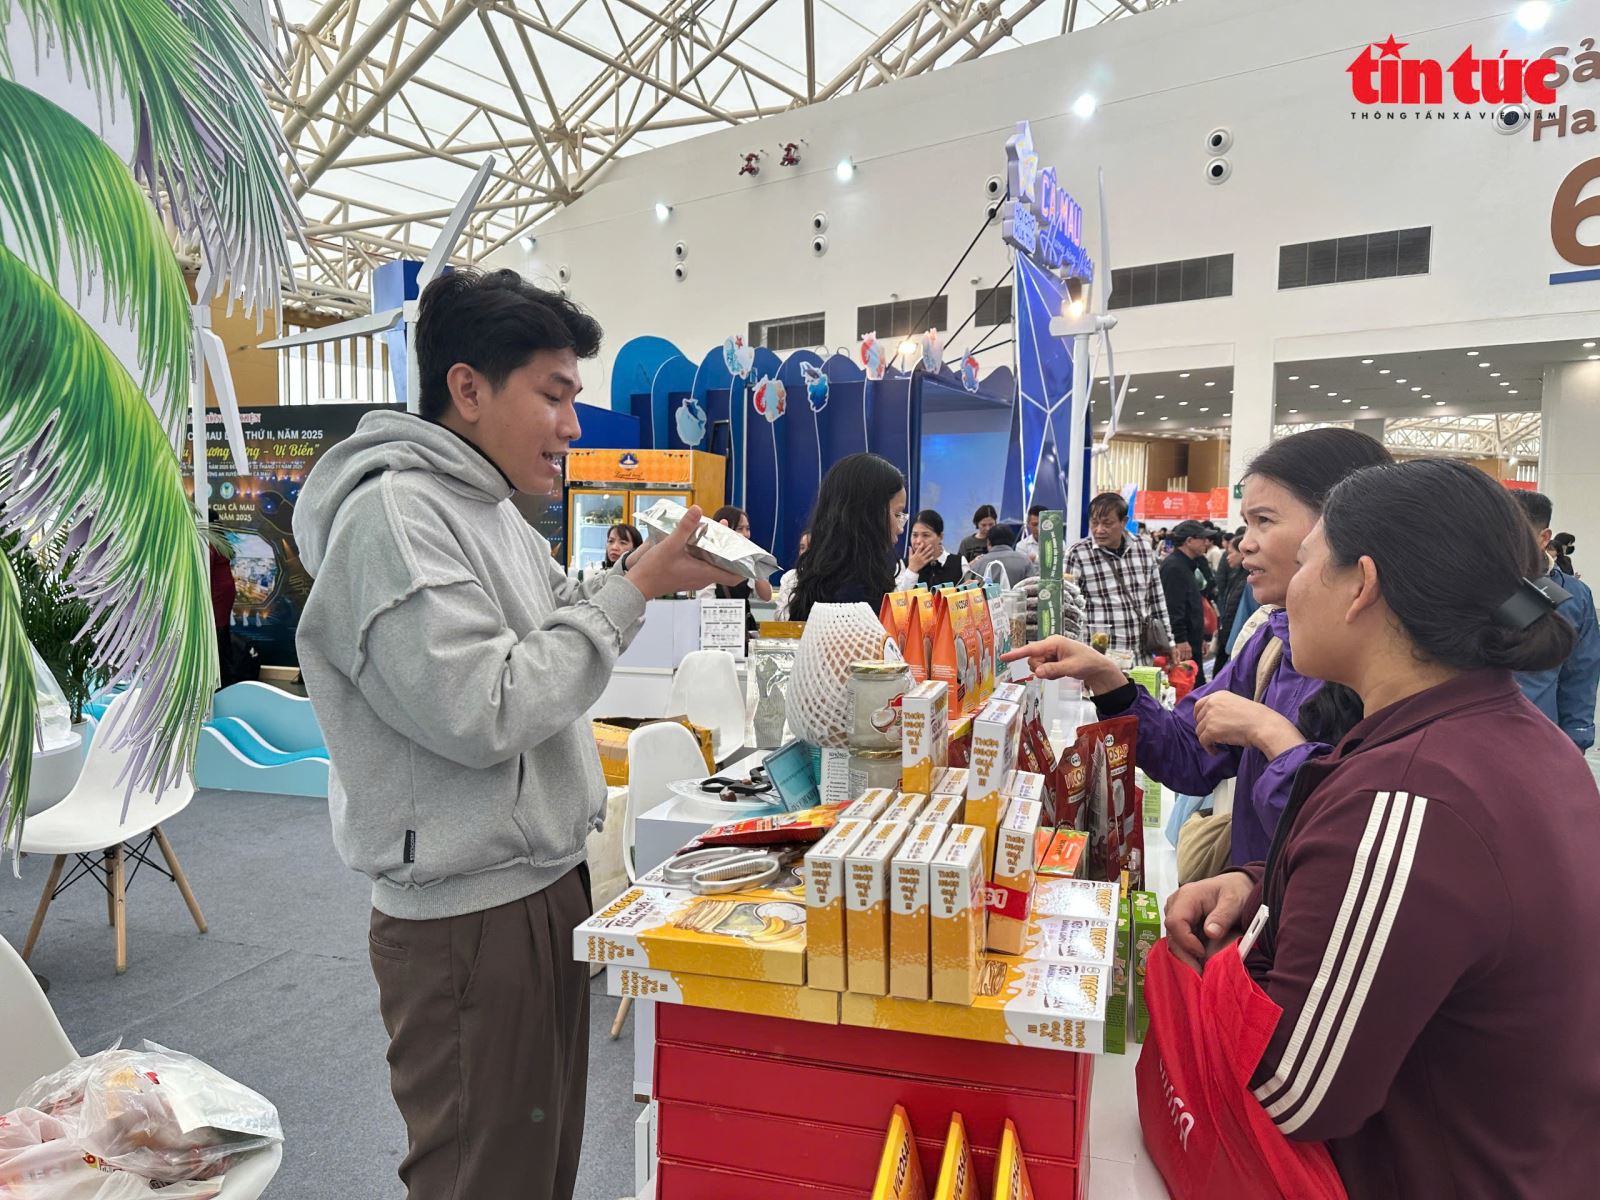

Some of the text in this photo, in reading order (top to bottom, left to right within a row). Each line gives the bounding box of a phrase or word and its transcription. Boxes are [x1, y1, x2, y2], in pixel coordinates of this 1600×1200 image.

[1041, 166, 1057, 226] CÀ
[1060, 187, 1083, 249] MAU
[245, 428, 265, 440] THỨ
[277, 427, 300, 440] NĂM
[301, 430, 324, 440] 2025
[236, 514, 252, 522] 2025
